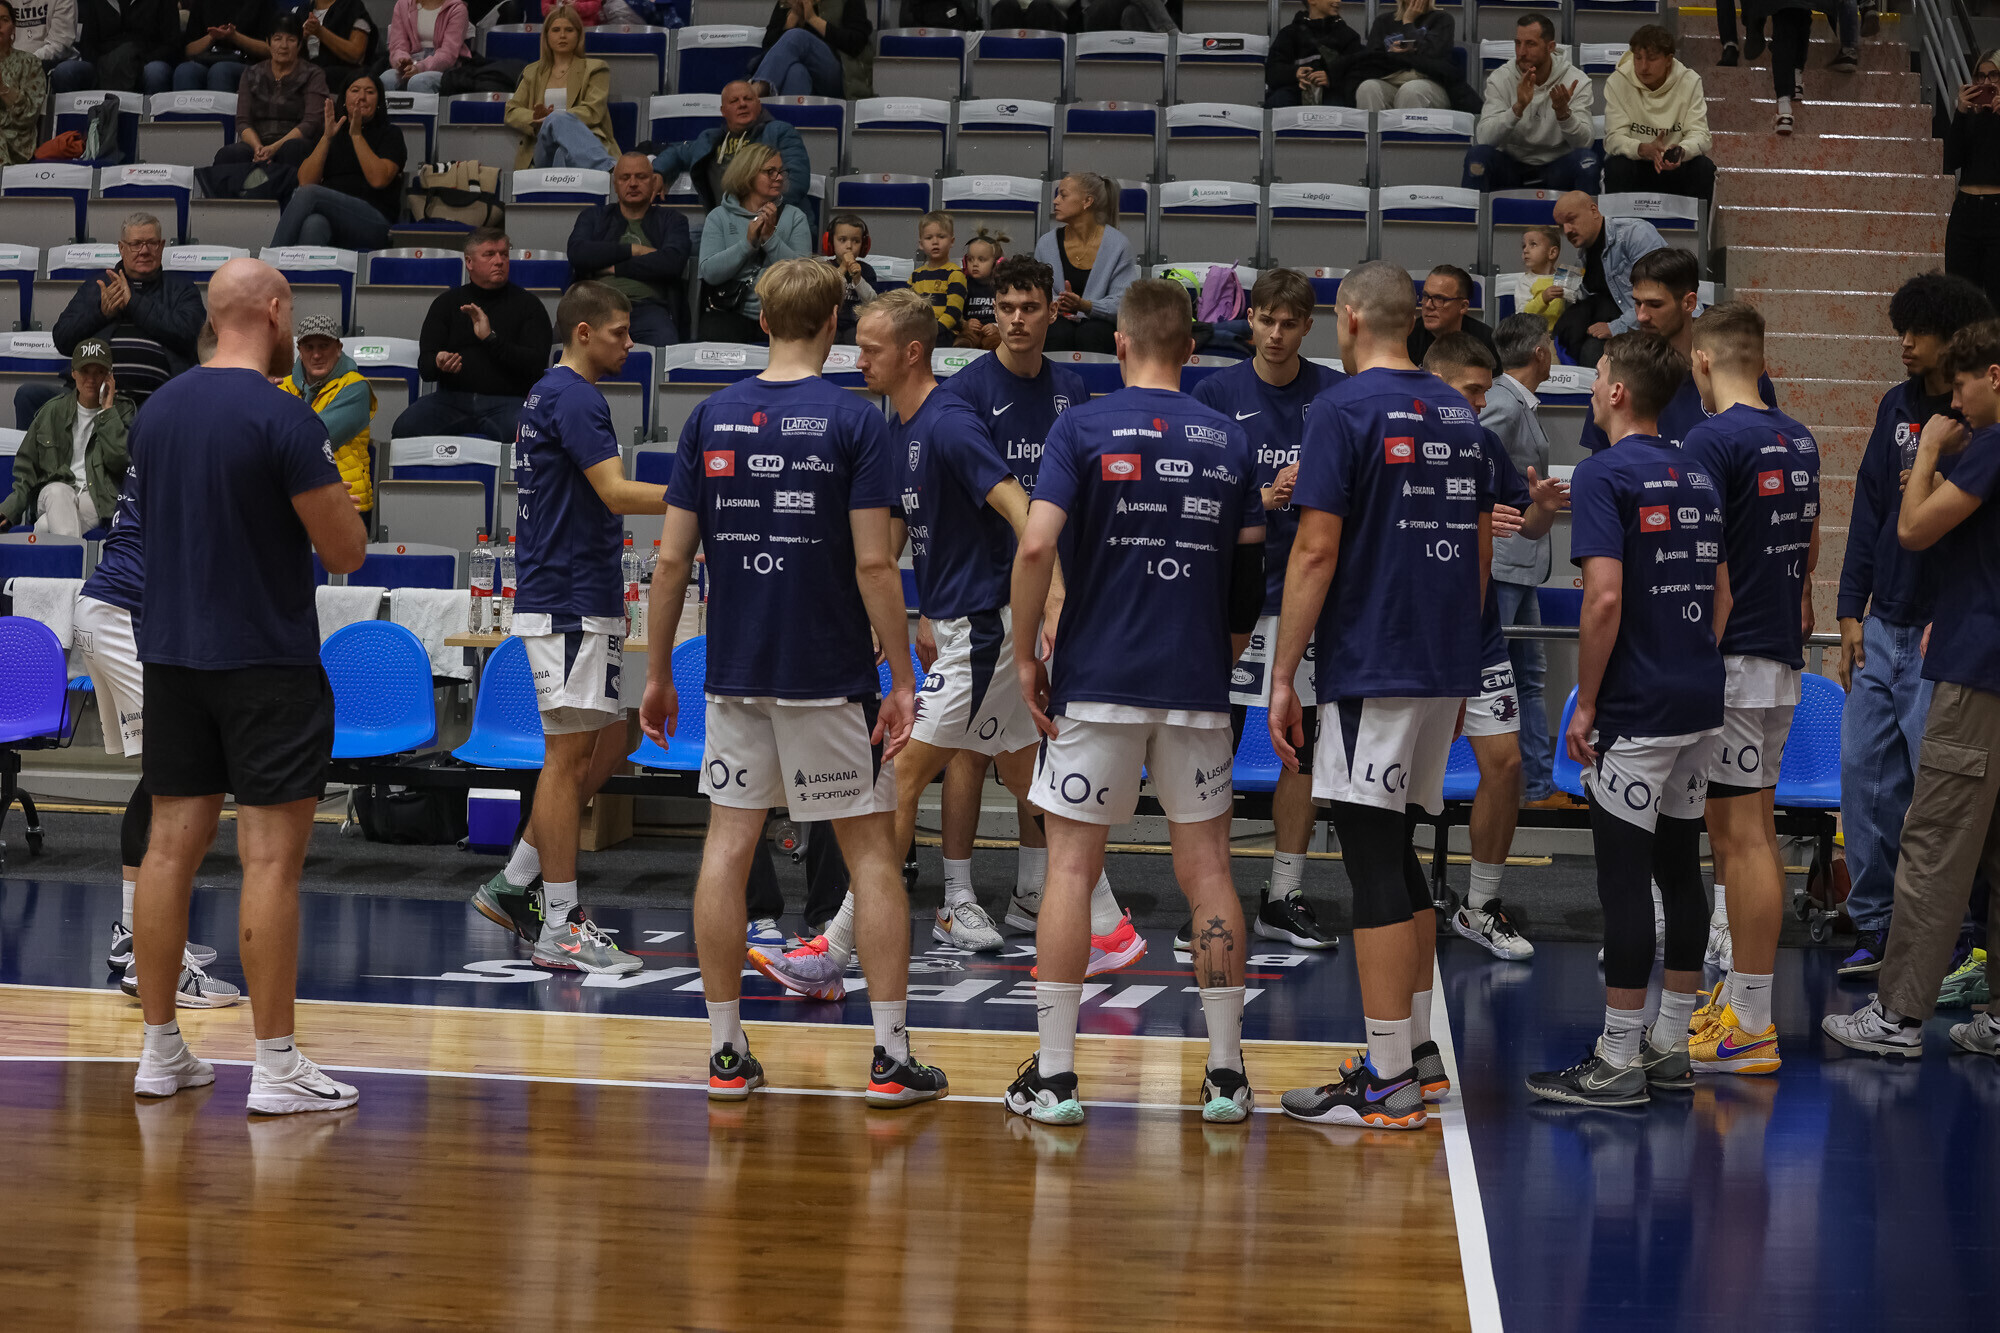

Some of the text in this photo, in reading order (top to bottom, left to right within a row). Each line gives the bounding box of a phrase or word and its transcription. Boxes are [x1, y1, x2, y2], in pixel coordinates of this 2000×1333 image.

[722, 498, 760, 508] LASKANA
[775, 491, 815, 508] BCS
[1128, 502, 1168, 513] LASKANA
[1184, 496, 1221, 517] BCS
[716, 533, 761, 542] SPORTLAND
[769, 535, 810, 545] teamsport.lv
[1120, 537, 1166, 547] SPORTLAND
[1682, 601, 1702, 623] LO
[1482, 670, 1514, 689] elvi
[808, 770, 859, 784] LASKANA
[812, 788, 861, 801] SPORTLAND
